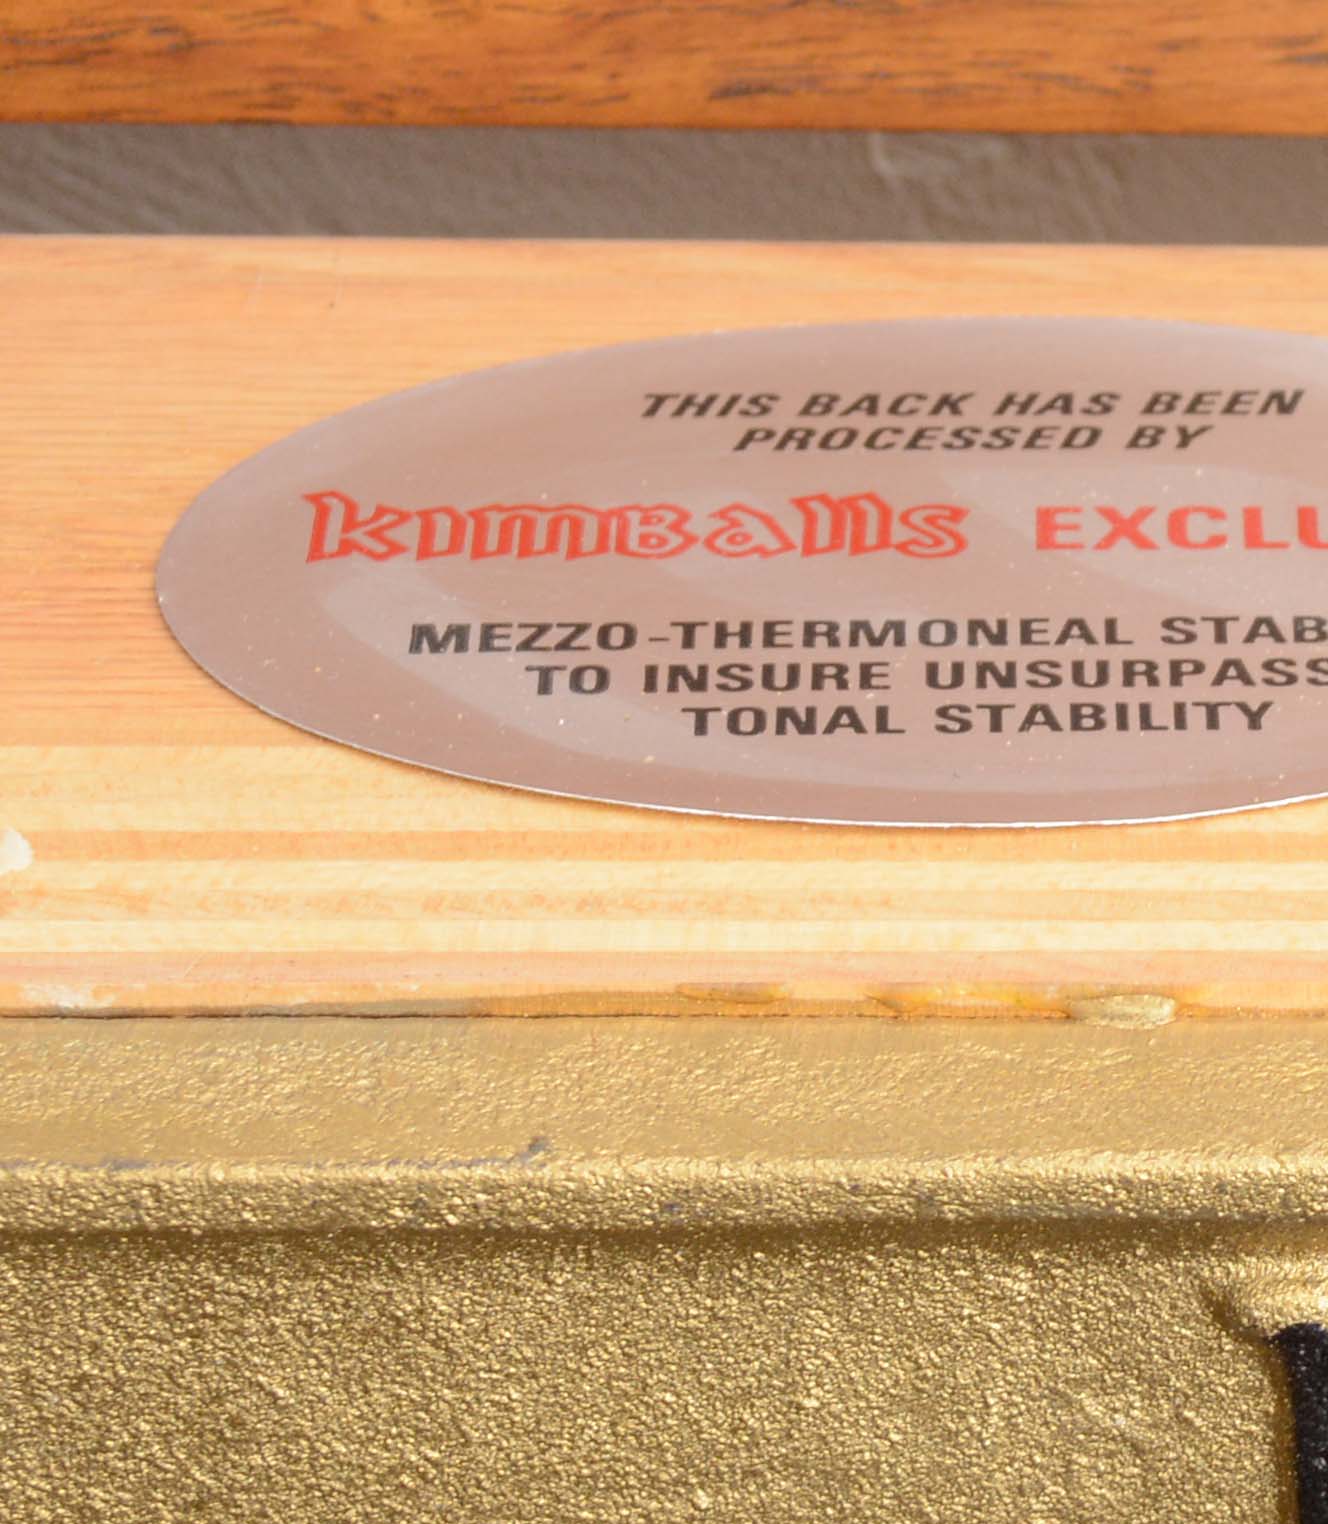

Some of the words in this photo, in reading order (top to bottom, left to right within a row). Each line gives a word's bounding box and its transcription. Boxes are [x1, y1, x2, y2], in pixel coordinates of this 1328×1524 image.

[641, 393, 782, 419] THIS
[797, 391, 972, 418] BACK
[992, 390, 1123, 416] HAS
[1139, 388, 1306, 415] BEEN
[732, 424, 1106, 452] PROCESSED
[1123, 424, 1212, 450] BY
[408, 617, 1136, 654] MEZZO-THERMONEAL
[525, 664, 611, 694] TO
[644, 661, 891, 692] INSURE
[681, 705, 906, 736] TONAL
[933, 700, 1275, 733] STABILITY
